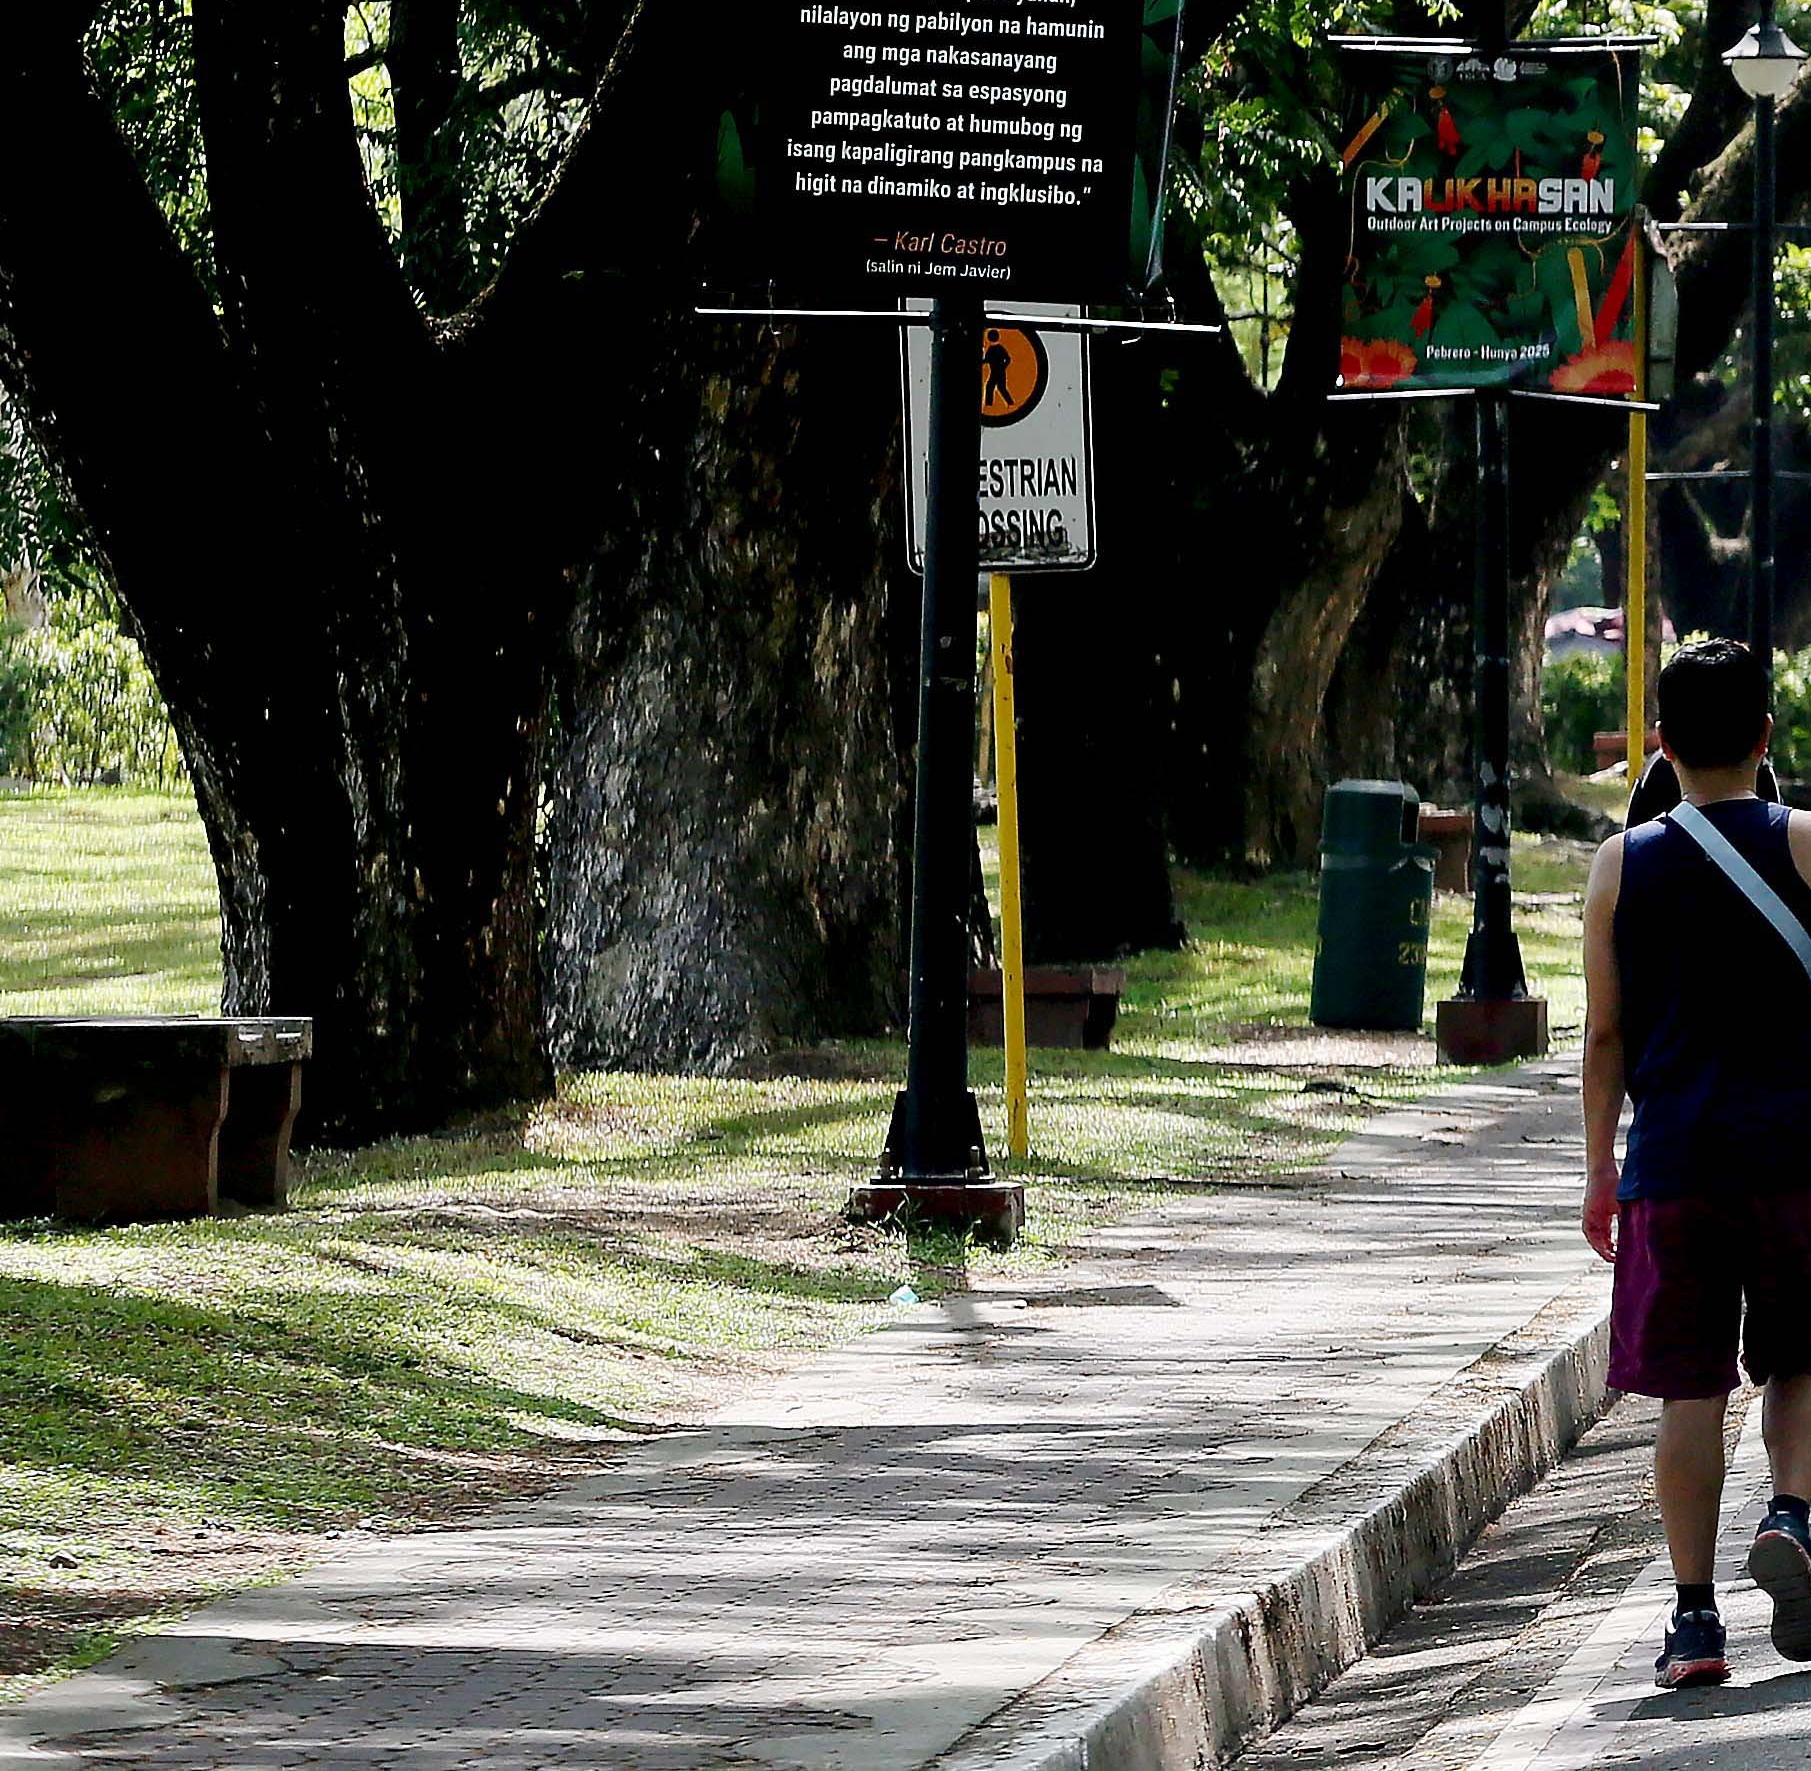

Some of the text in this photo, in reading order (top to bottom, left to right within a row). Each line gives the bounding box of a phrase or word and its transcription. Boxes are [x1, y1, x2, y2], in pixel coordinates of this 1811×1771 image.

[800, 4, 1105, 39] nilalayon ng pabilyon na hamunin
[843, 44, 1057, 75] ang mga nakasanayang
[830, 74, 1067, 109] pagdalumat sa espasyong
[811, 108, 1083, 143] pampagkatuto at humubog ng
[787, 138, 1103, 175] isang kapaligirang pangkampus na
[795, 171, 837, 196] higit
[841, 179, 863, 194] na
[867, 175, 951, 198] dinamiko
[956, 182, 975, 200] at
[1366, 176, 1614, 214] KALIKHASAN
[1367, 216, 1612, 234] Outdoor Art Projects on Campus Ecology
[894, 230, 936, 253] Karl
[940, 233, 1008, 258] Castro
[866, 258, 1011, 281] (salin ni Jem Javier)
[1426, 344, 1471, 360] Pebrero
[1480, 344, 1518, 361] Hunyo
[1519, 343, 1550, 359] 2025
[925, 456, 1077, 498] ESTRIAN
[979, 508, 1064, 548] OSSING
